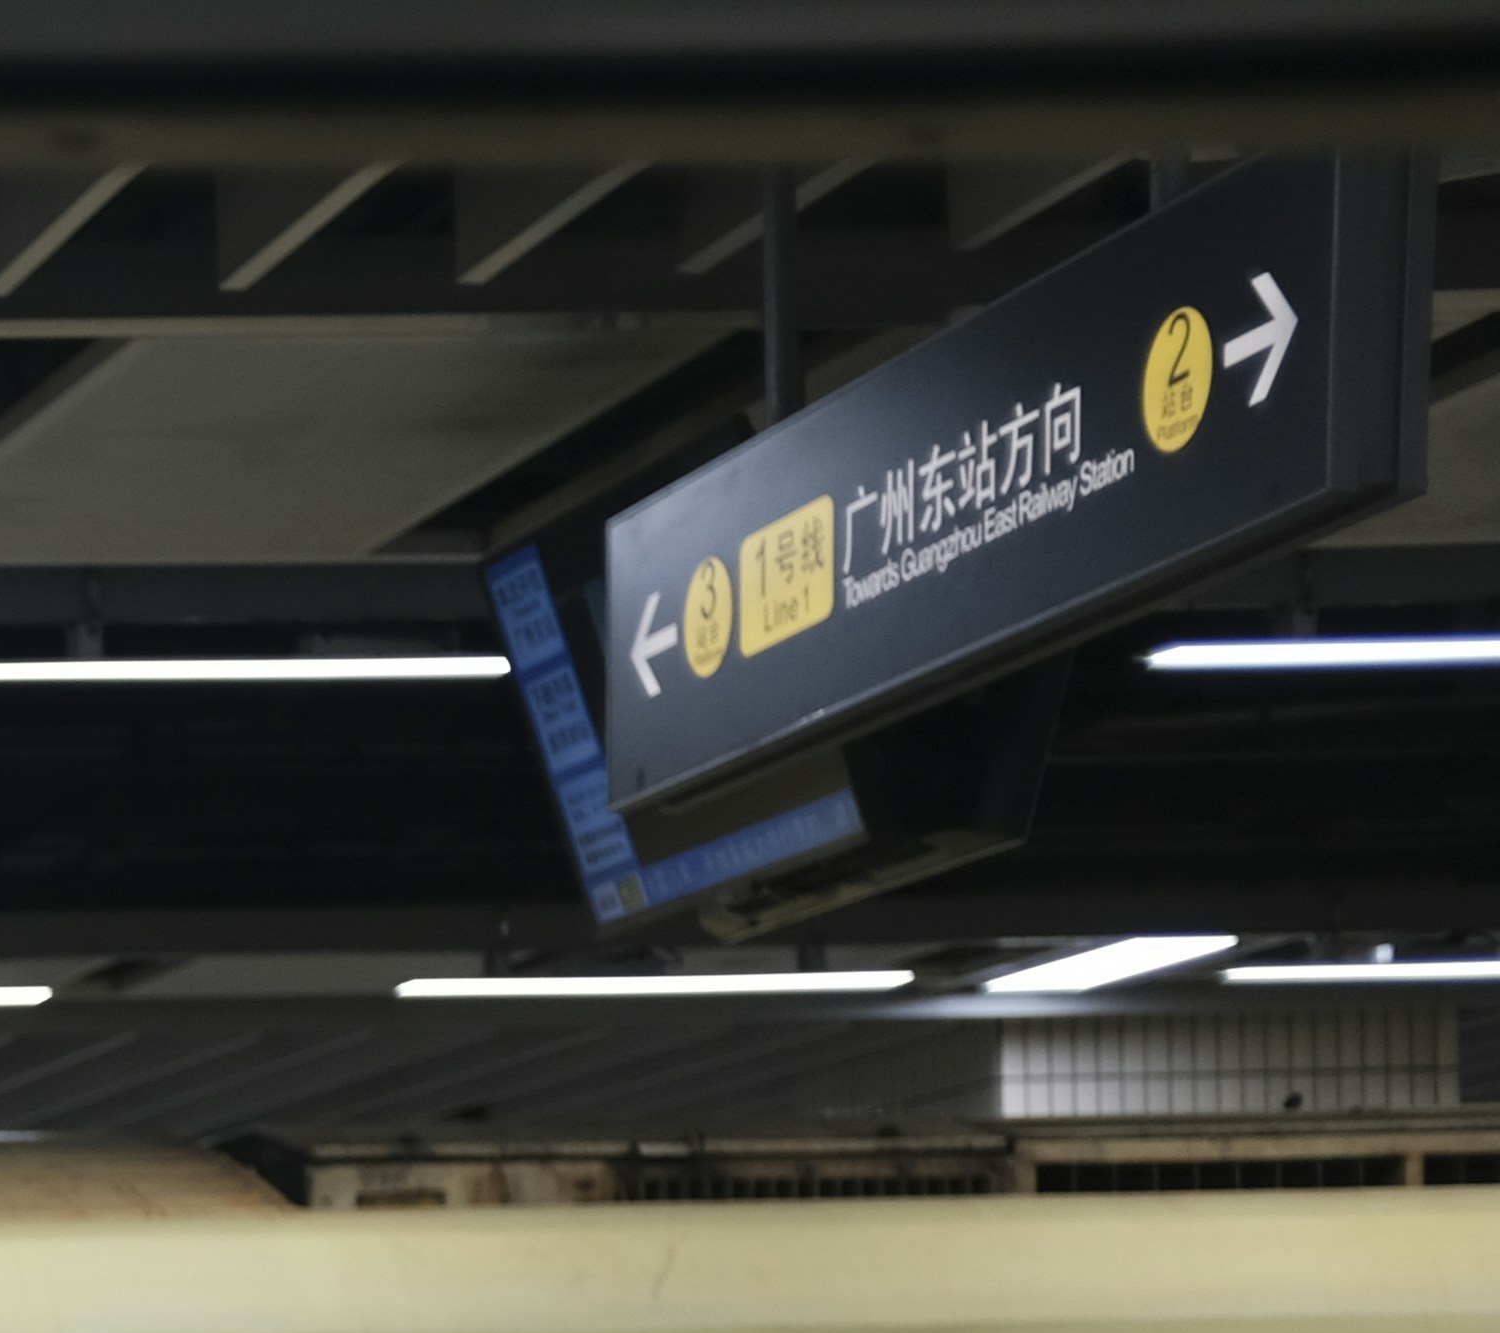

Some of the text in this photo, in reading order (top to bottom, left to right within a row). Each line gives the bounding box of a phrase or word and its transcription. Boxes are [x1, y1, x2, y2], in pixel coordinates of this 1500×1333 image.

[1168, 312, 1191, 386] 2
[843, 382, 1083, 573] 广州东站方向
[842, 448, 1136, 608] Towards Guangzhou East Railway Station
[700, 558, 717, 620] 3
[764, 597, 798, 632] Line
